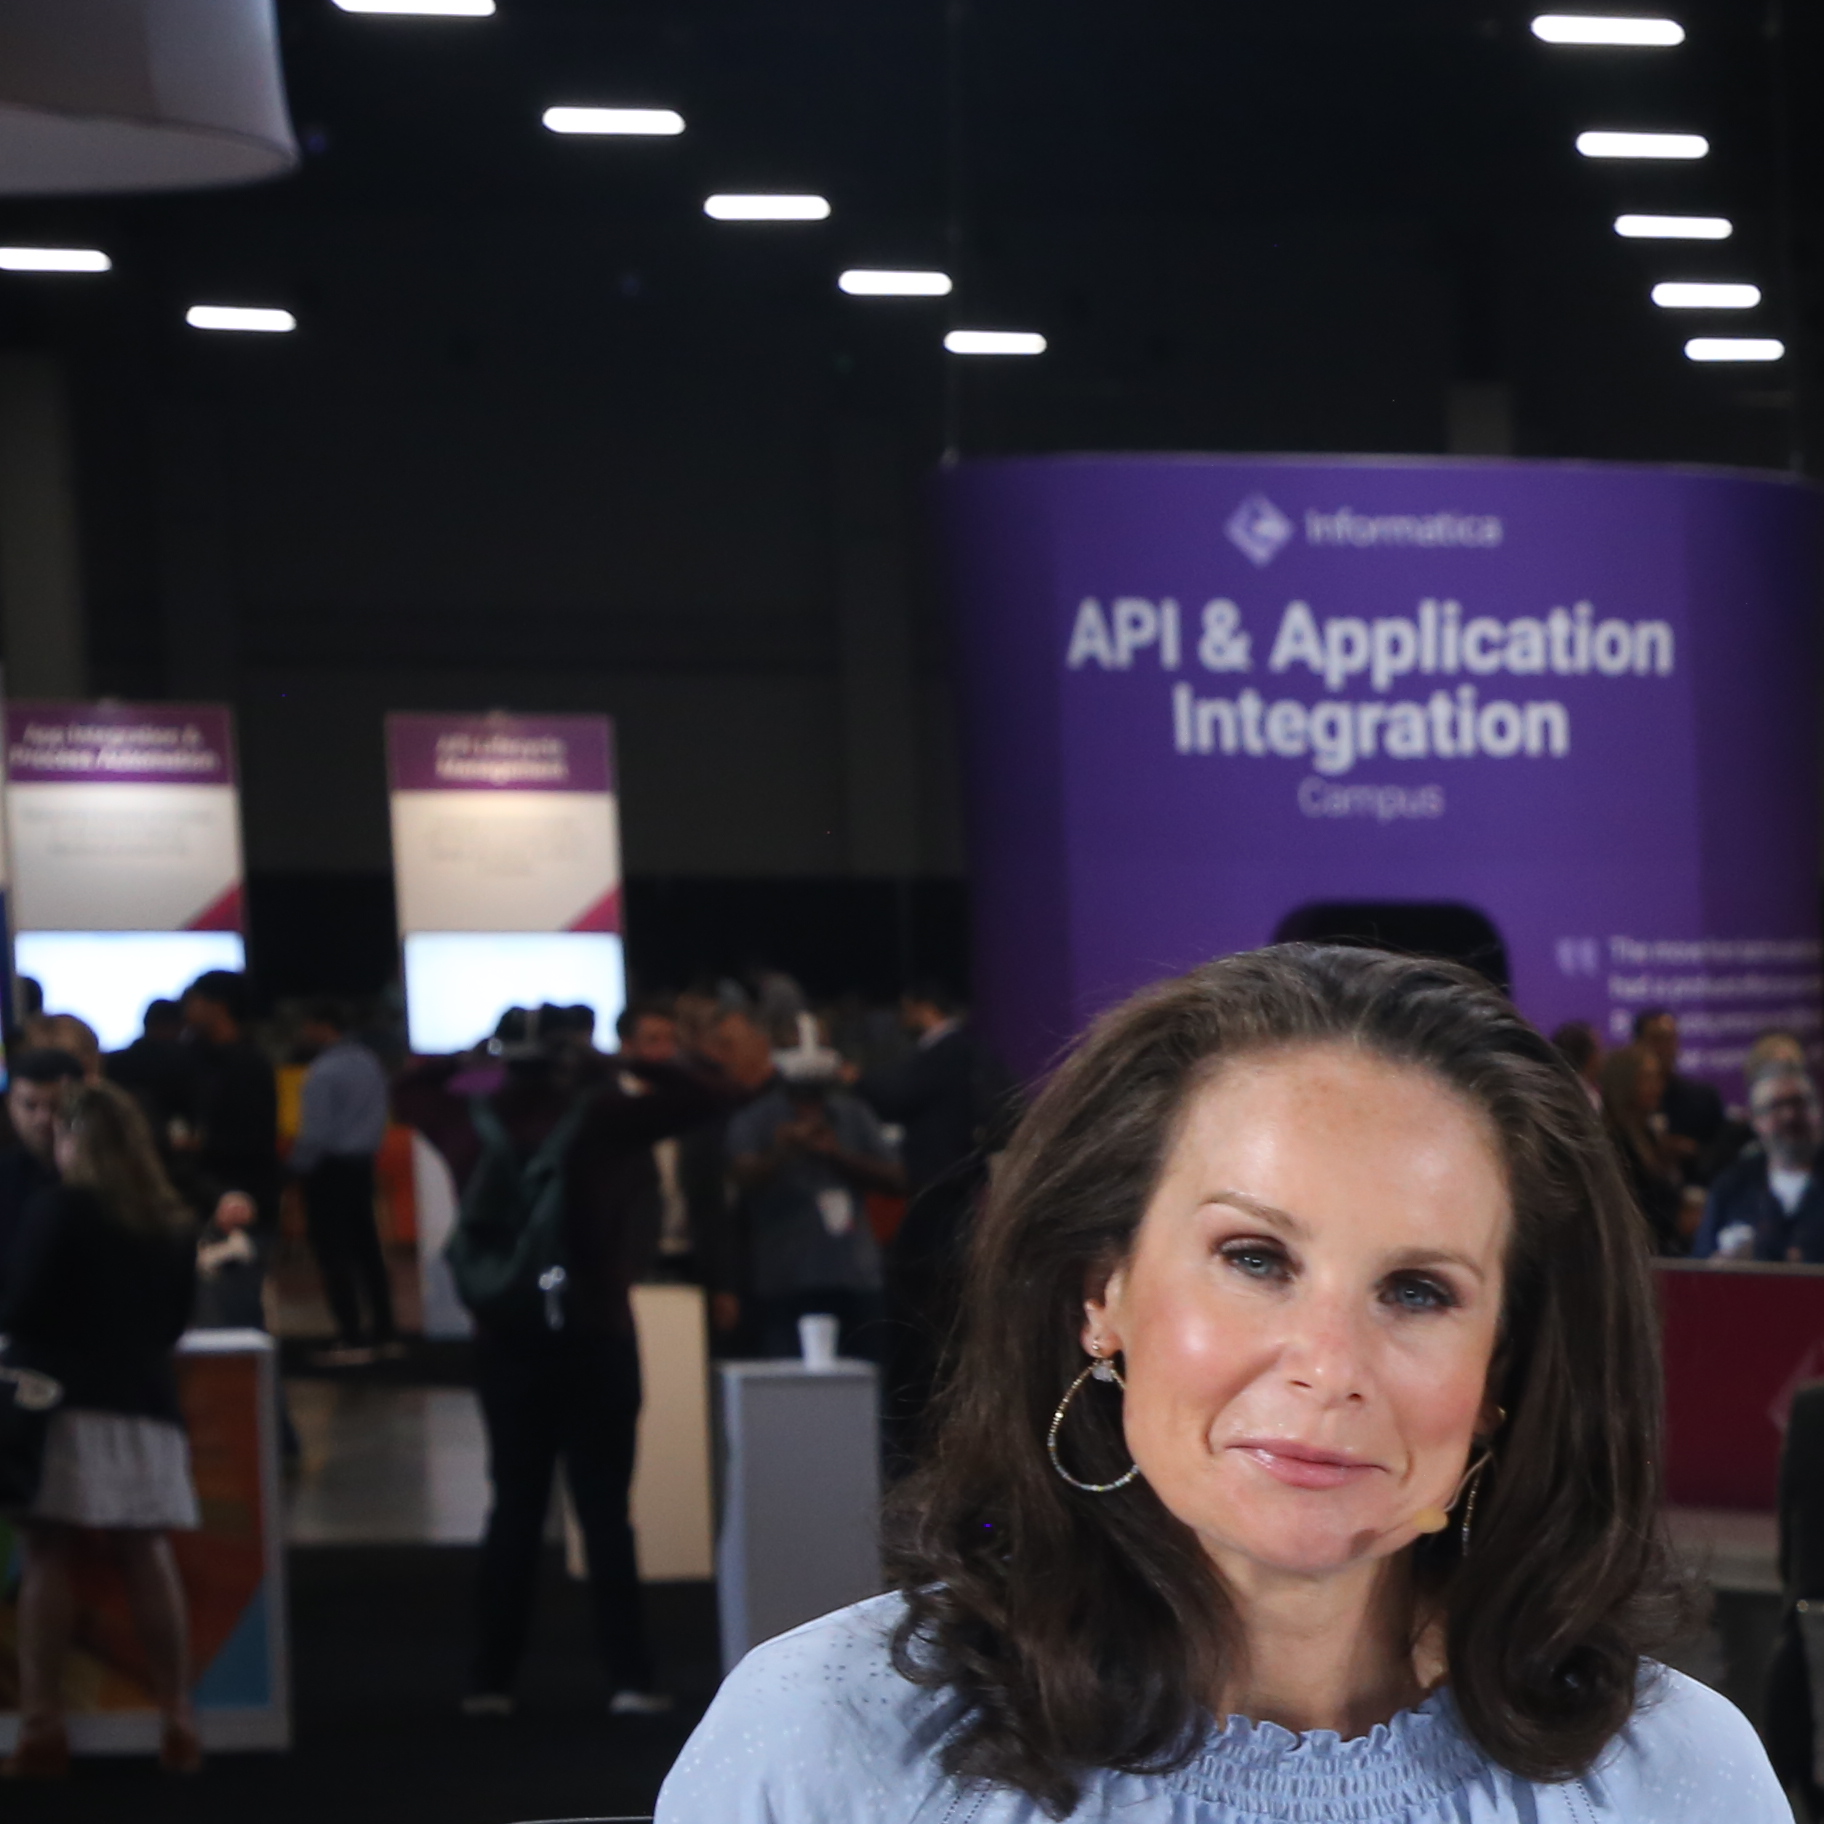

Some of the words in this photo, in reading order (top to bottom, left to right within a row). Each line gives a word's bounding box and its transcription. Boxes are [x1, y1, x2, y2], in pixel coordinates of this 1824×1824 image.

[1306, 508, 1503, 547] Informatica
[1066, 598, 1181, 671] API
[1198, 598, 1252, 674] &
[1268, 598, 1675, 692] Application
[1172, 681, 1570, 776] Integration
[1298, 776, 1444, 822] Campus
